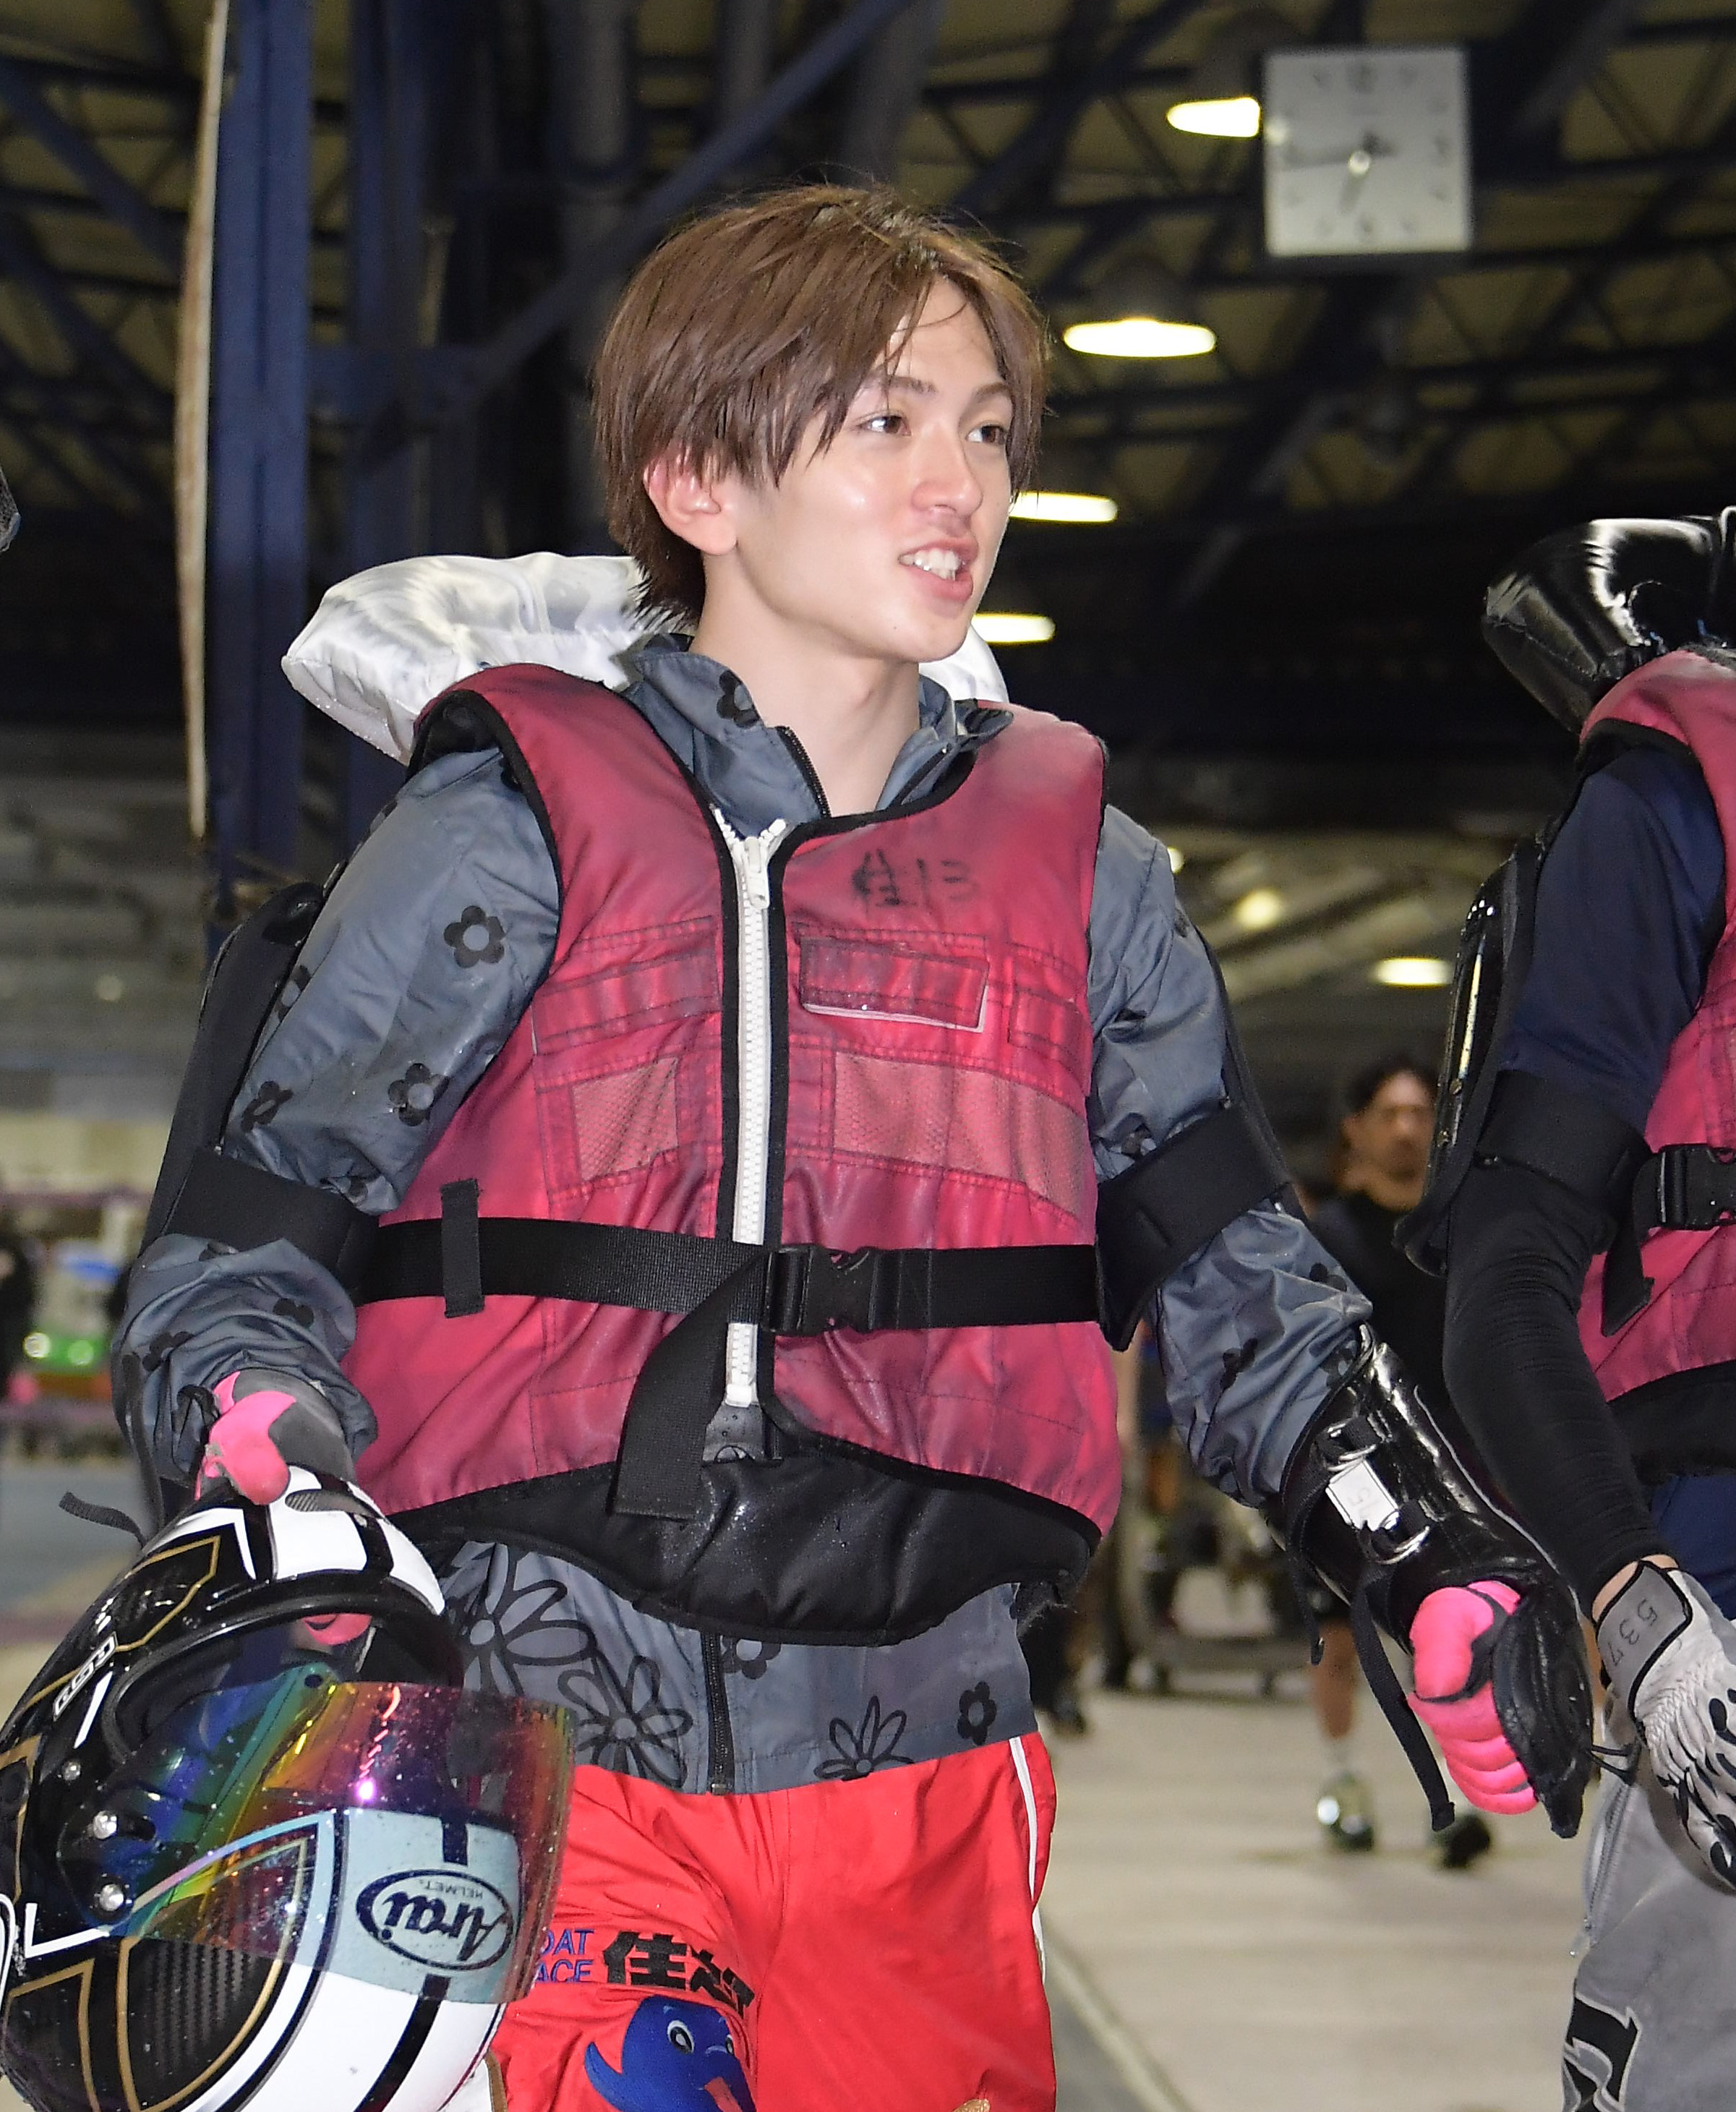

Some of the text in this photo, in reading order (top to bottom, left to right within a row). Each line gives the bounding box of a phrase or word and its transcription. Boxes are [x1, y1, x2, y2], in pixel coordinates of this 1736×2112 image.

[424, 1880, 484, 1899] HELMET
[382, 1890, 508, 1962] Arai
[535, 1959, 594, 1983] ACE
